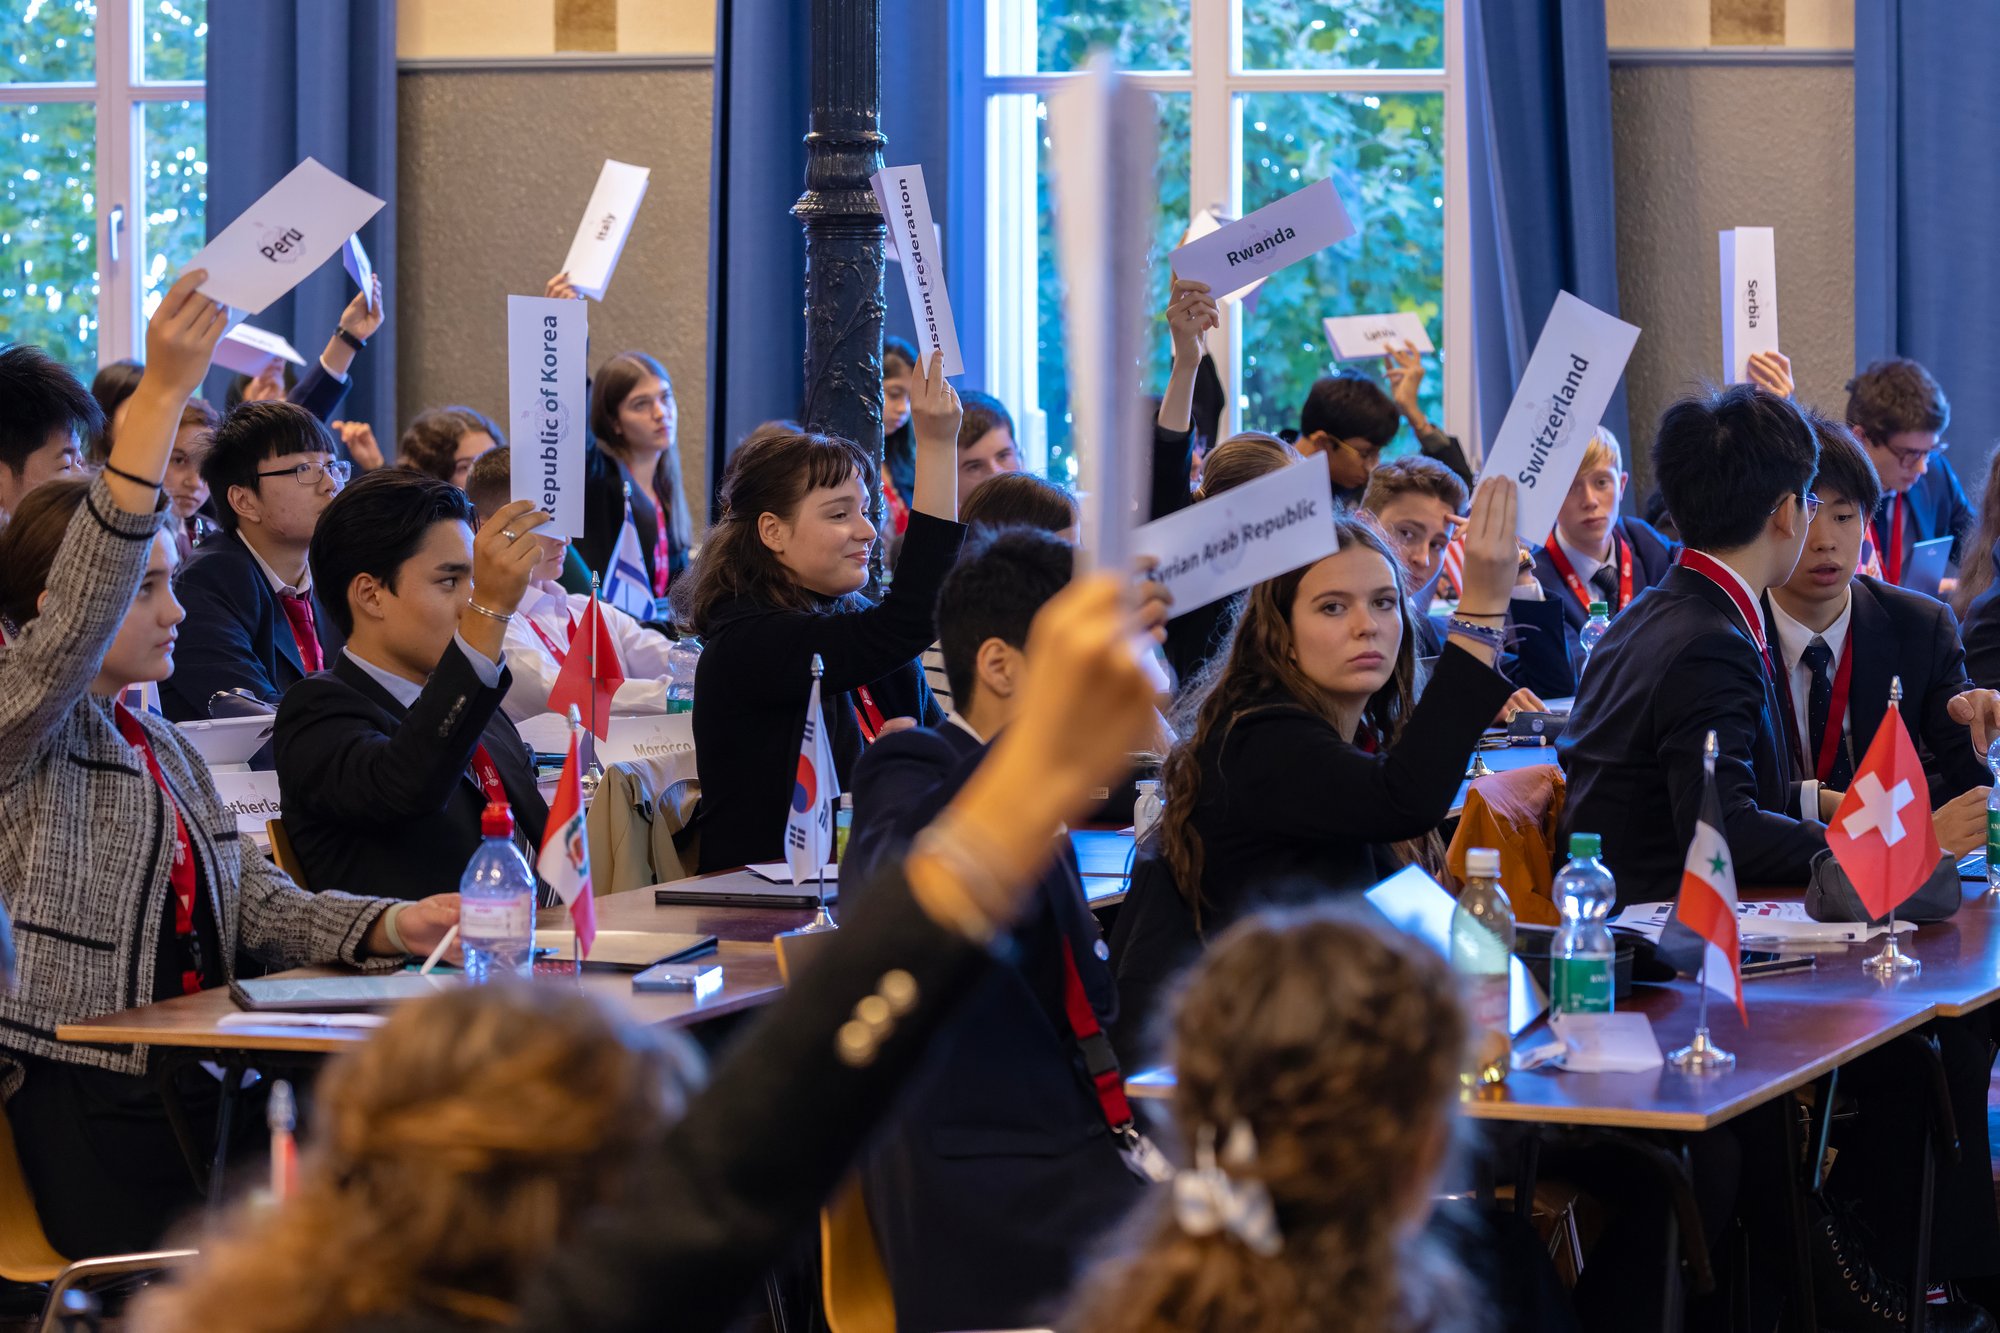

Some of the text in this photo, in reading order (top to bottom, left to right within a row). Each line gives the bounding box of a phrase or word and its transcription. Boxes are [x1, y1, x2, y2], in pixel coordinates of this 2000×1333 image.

[260, 227, 304, 263] Peru
[594, 211, 617, 242] Italy
[899, 178, 929, 288] Federation
[1226, 227, 1296, 267] Rwanda
[1747, 279, 1760, 329] Serbia
[540, 315, 558, 383] Korea
[540, 387, 559, 413] of
[1518, 352, 1590, 490] Switzerland
[1201, 529, 1240, 566] Arab
[1240, 499, 1317, 546] Republic
